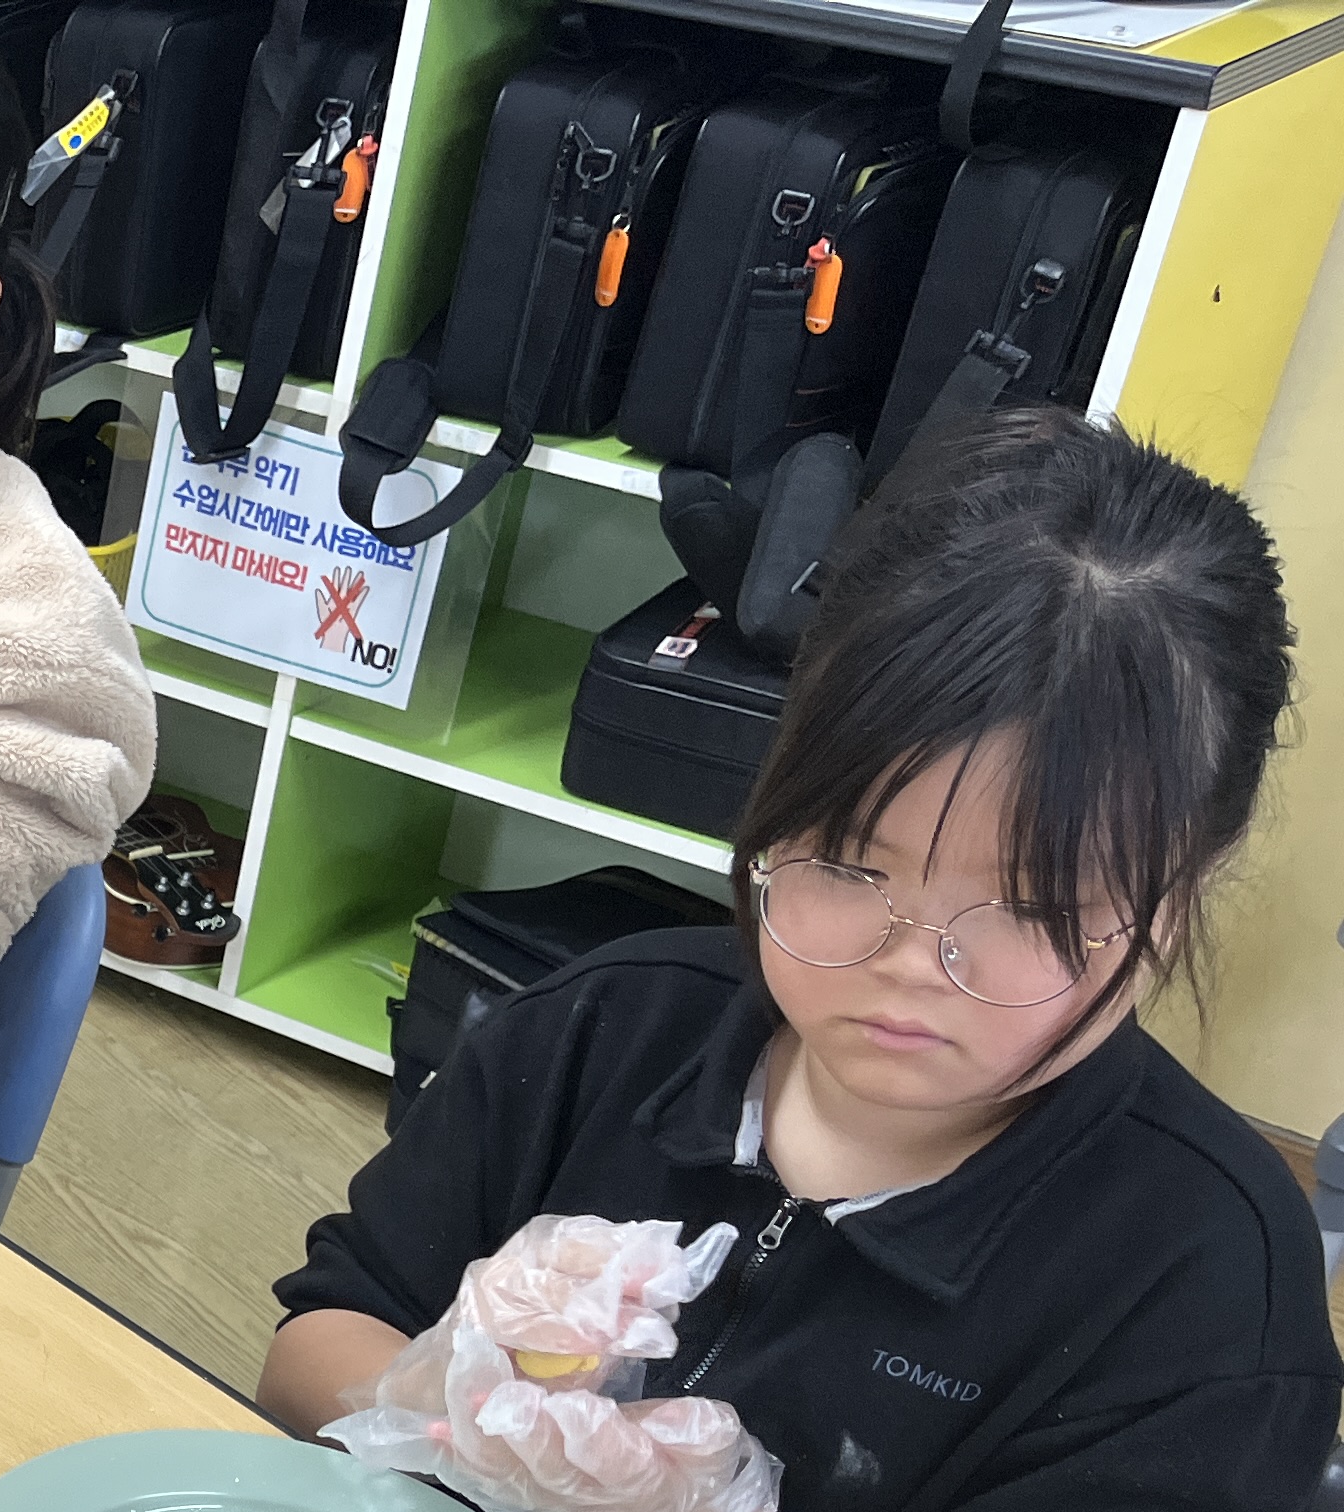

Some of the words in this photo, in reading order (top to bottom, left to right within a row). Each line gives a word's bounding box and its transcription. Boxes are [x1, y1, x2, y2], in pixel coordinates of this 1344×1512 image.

[254, 455, 300, 496] 악기
[173, 479, 310, 545] 수업시간에만
[311, 521, 416, 572] 사용해요
[165, 522, 230, 569] 만지지
[231, 545, 309, 592] 마세요!
[350, 638, 398, 674] NO!
[871, 1348, 983, 1402] TOMKID
